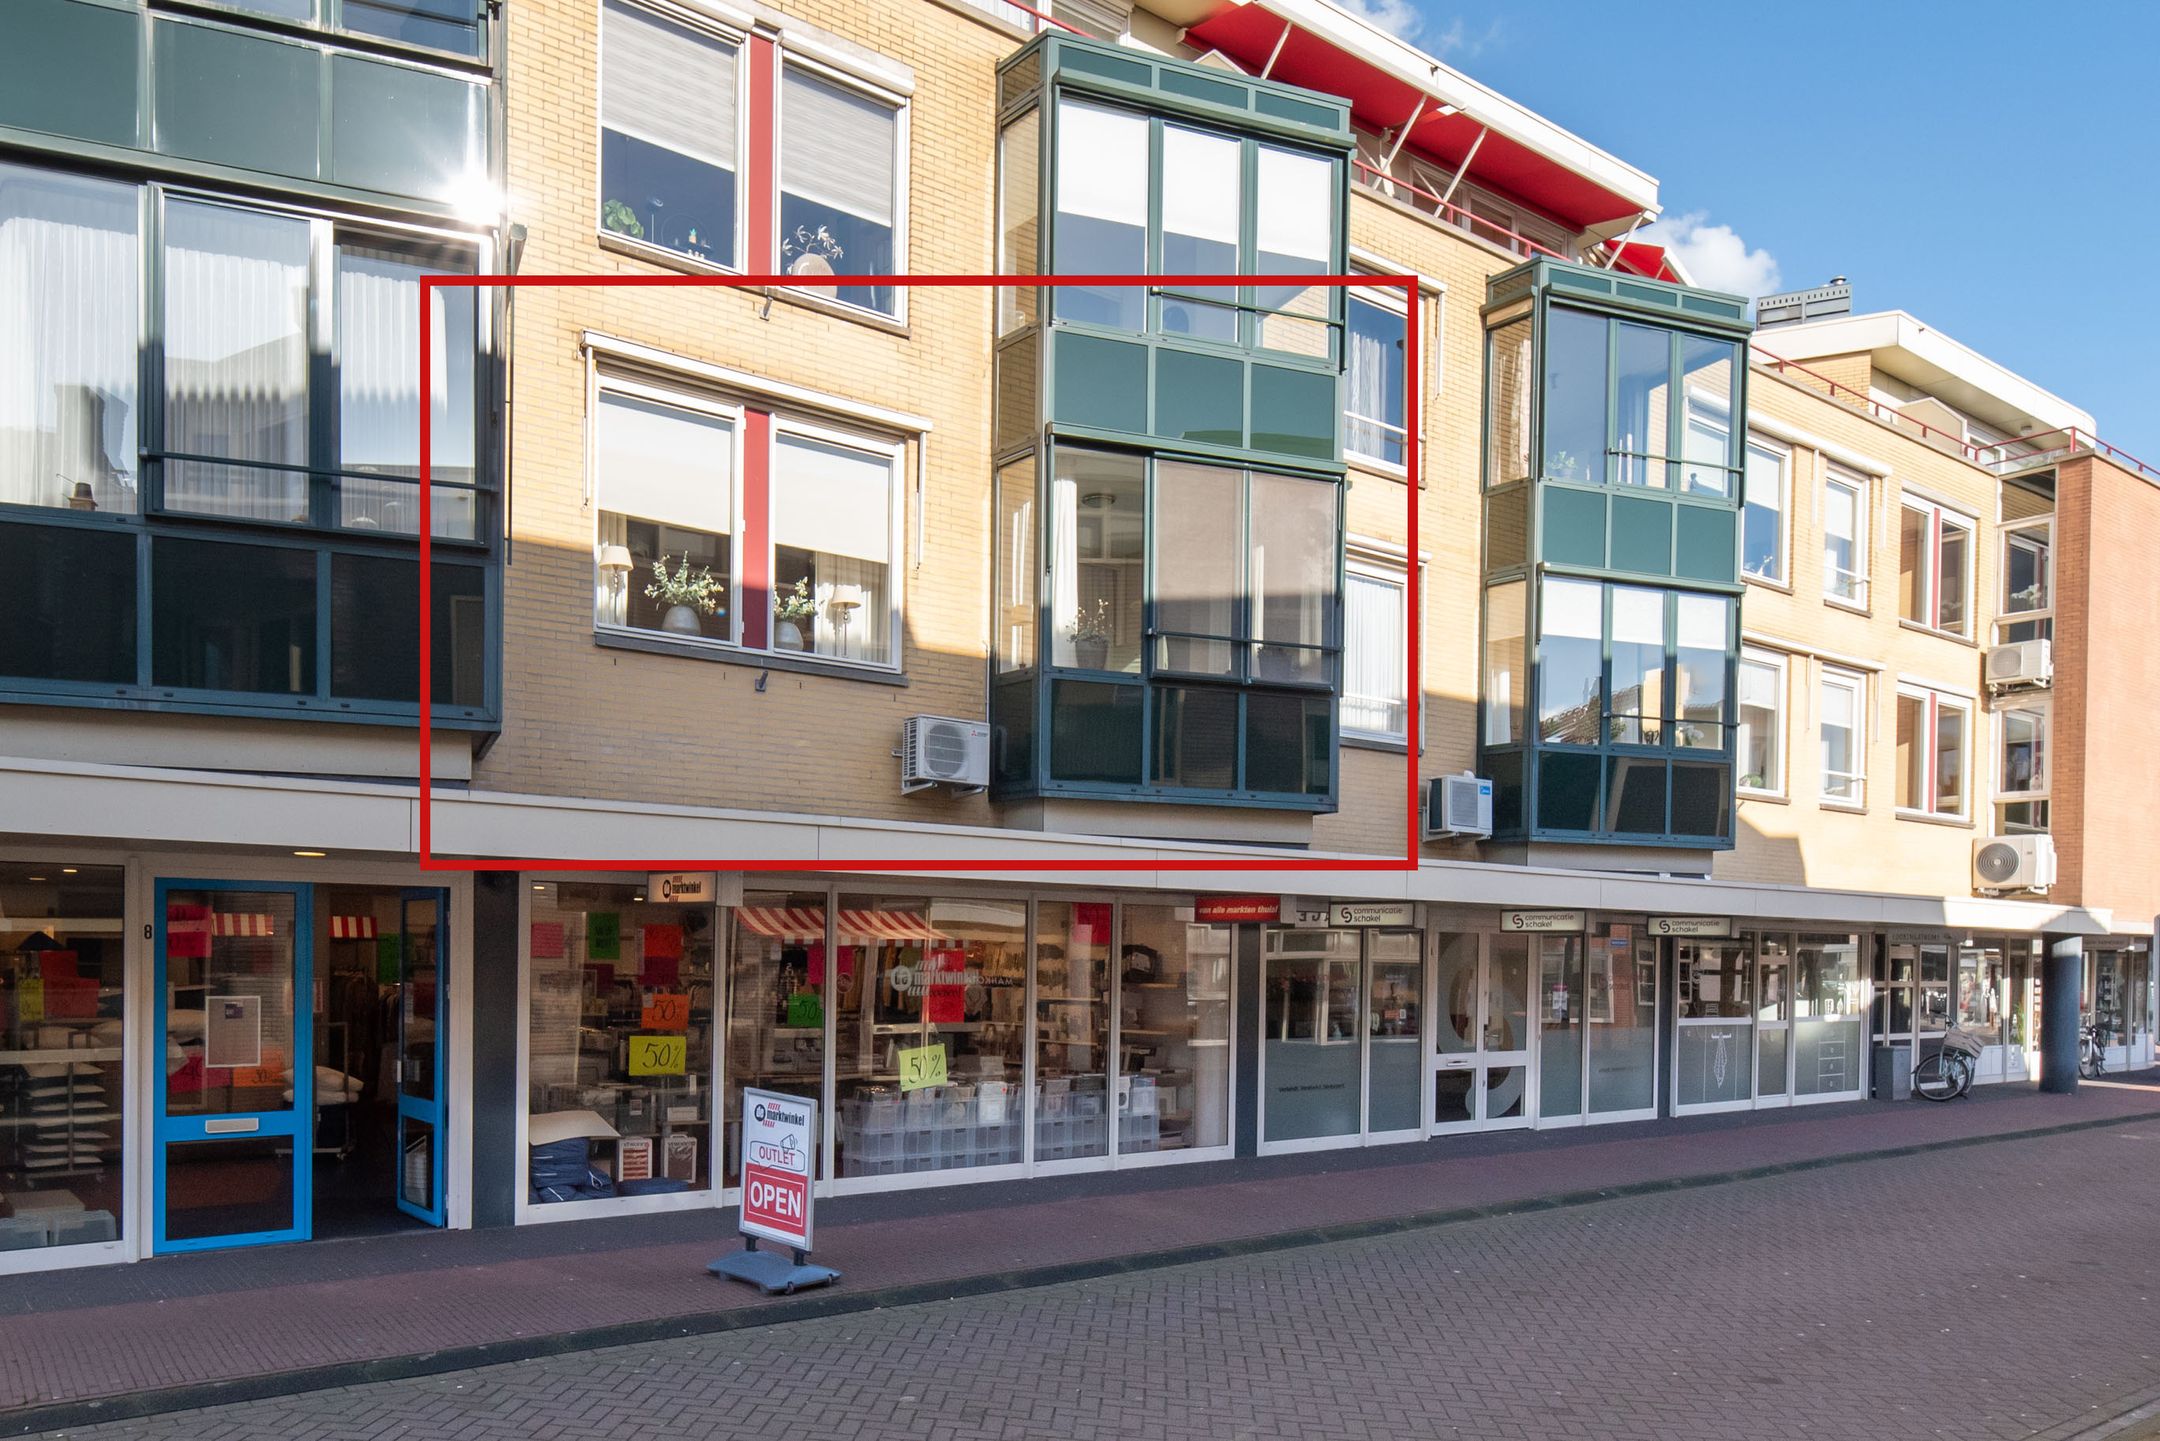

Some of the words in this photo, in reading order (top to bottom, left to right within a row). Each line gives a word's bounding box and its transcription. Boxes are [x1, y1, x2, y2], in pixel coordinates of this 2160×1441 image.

[1353, 906, 1403, 915] communicatie
[1353, 914, 1381, 922] schakel
[1525, 912, 1575, 921] communicatie
[1525, 919, 1553, 928] schakel
[1671, 918, 1720, 927] communicatie
[1671, 925, 1699, 933] schakel
[642, 1043, 682, 1069] 50%
[909, 1053, 942, 1084] 50%
[766, 1109, 805, 1127] marktwinkel
[759, 1145, 796, 1167] OUTLET
[750, 1180, 801, 1219] OPEN
